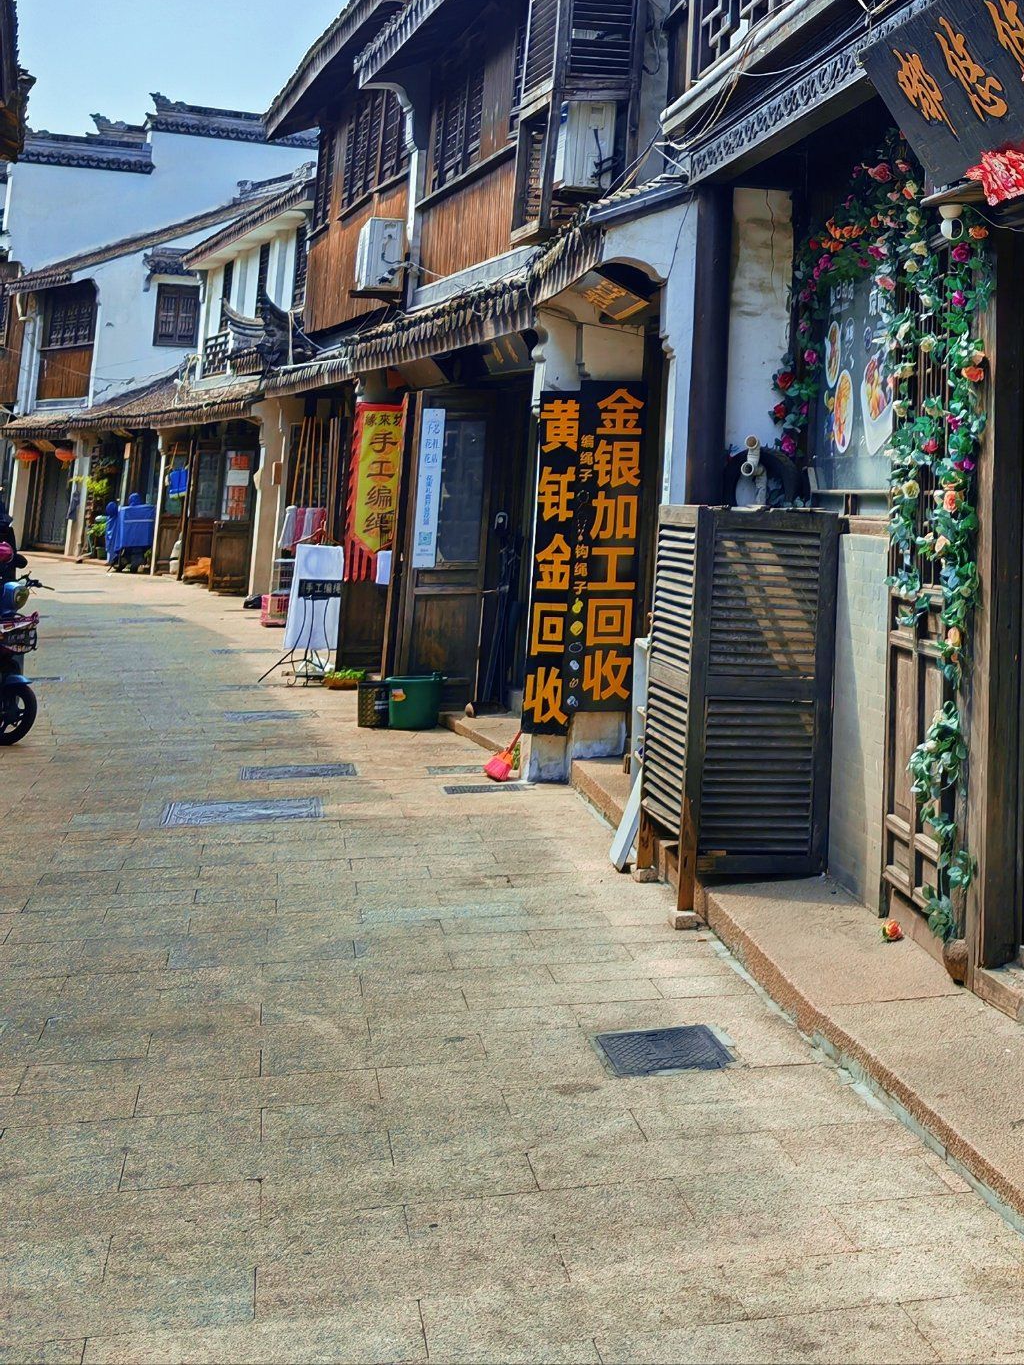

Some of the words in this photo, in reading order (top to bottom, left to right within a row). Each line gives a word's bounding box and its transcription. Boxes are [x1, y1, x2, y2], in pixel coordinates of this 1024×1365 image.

[582, 388, 645, 701] 金银加工回收
